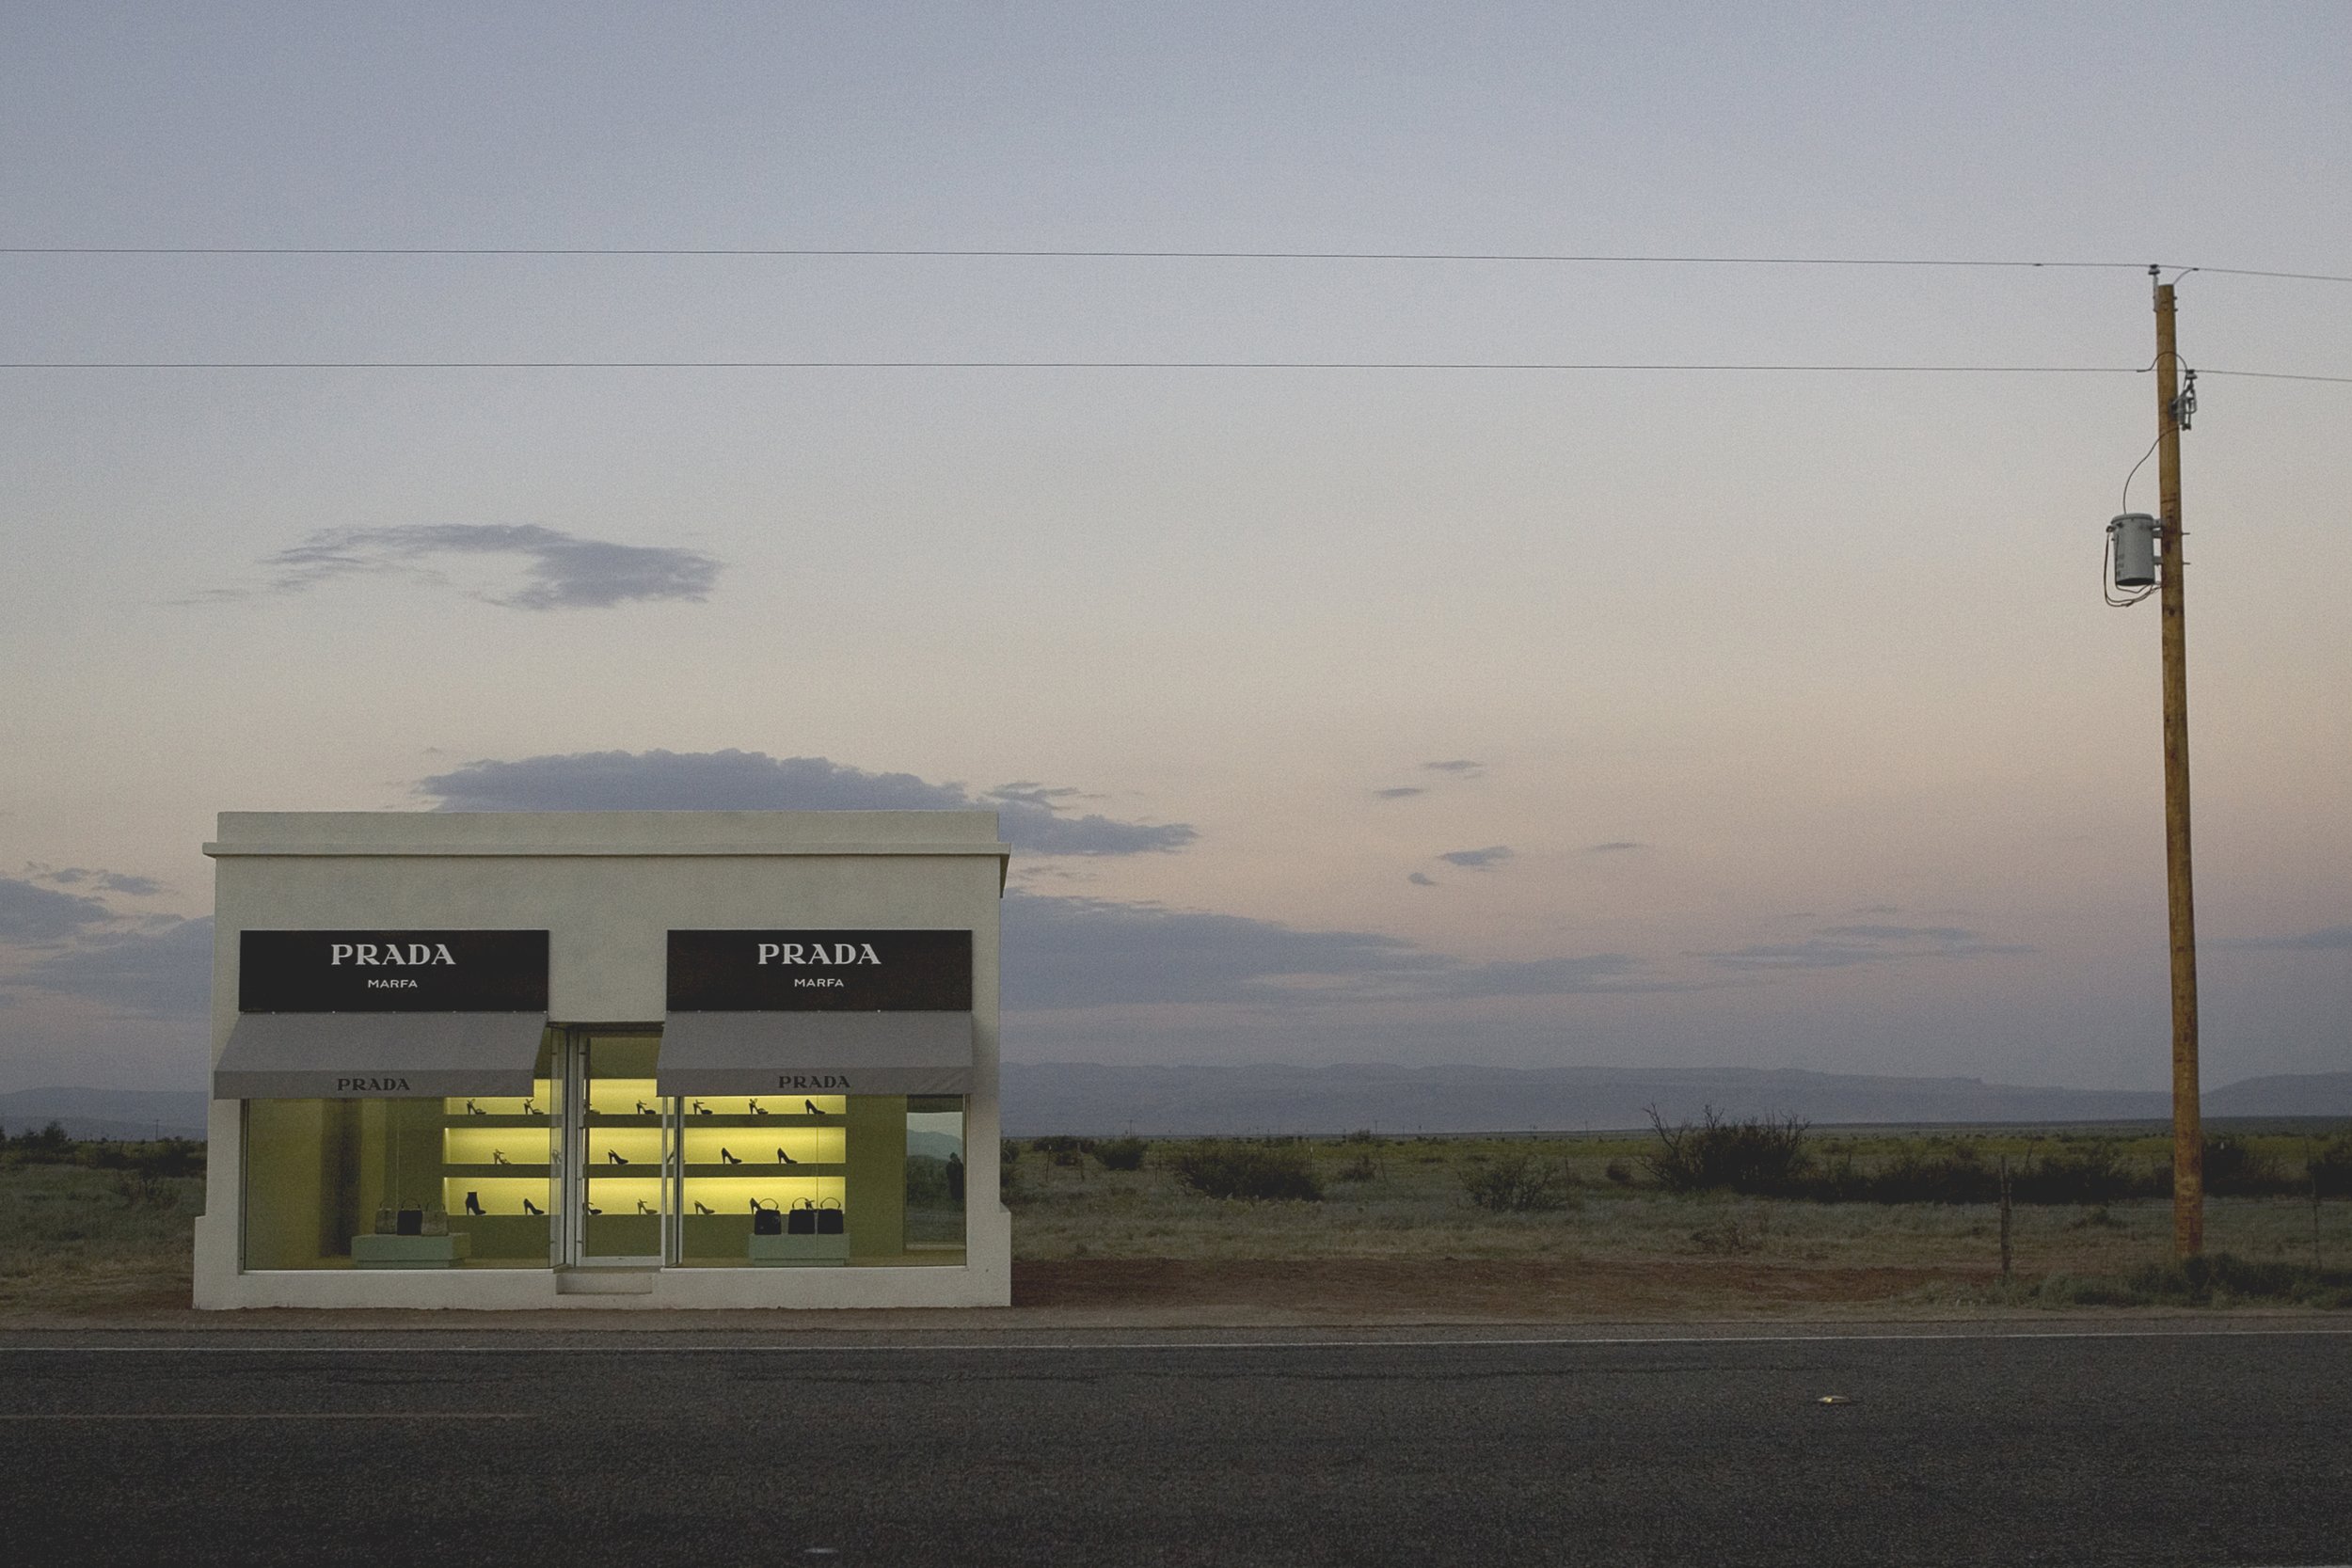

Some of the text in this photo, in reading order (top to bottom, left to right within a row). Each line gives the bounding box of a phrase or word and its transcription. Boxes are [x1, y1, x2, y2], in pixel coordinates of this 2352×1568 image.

[331, 944, 456, 966] PRADA
[758, 943, 882, 966] PRADA
[368, 979, 418, 989] MARFA
[794, 978, 844, 988] MARFA
[337, 1078, 410, 1091] PRADA
[778, 1075, 850, 1089] PRADA
